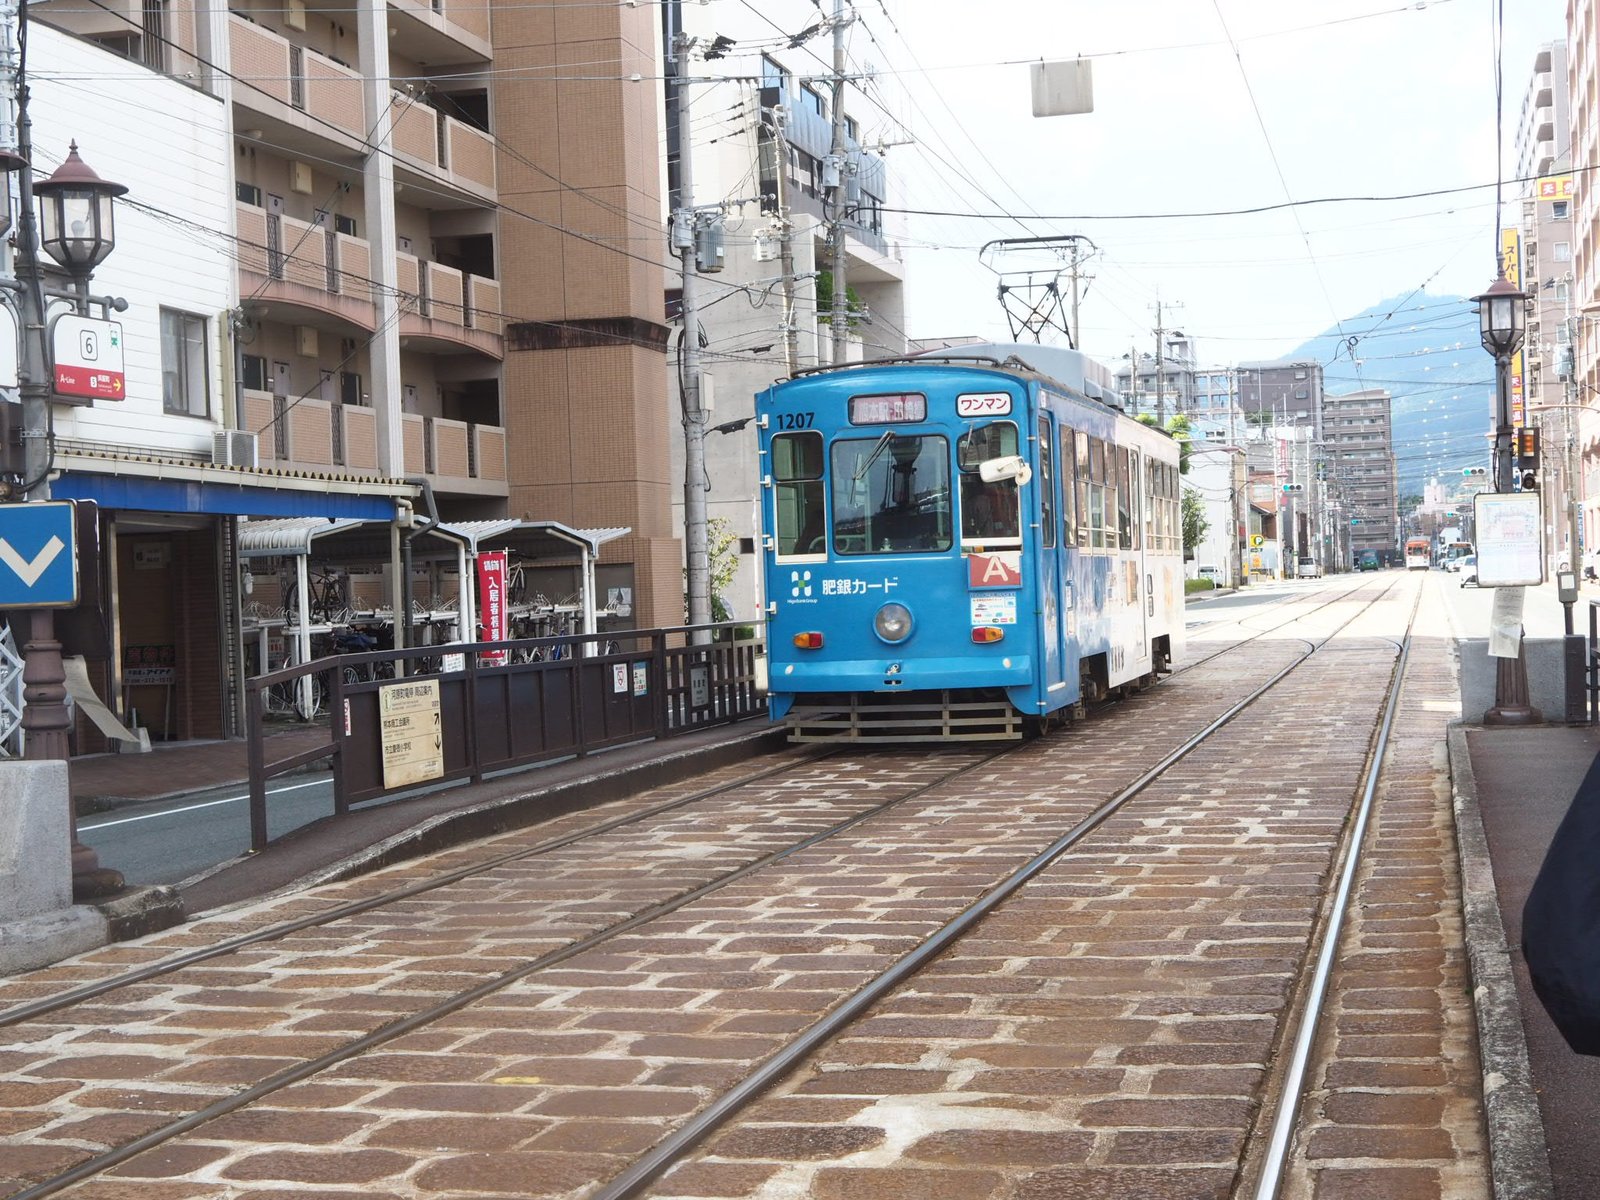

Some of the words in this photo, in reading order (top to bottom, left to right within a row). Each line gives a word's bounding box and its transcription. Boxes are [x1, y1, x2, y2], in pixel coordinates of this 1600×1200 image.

[1505, 246, 1517, 285] スーパー
[85, 337, 93, 354] 6
[961, 397, 1007, 412] ワンマン
[776, 412, 815, 430] 1207
[982, 555, 1009, 584] A
[822, 577, 898, 596] 肥銀カード
